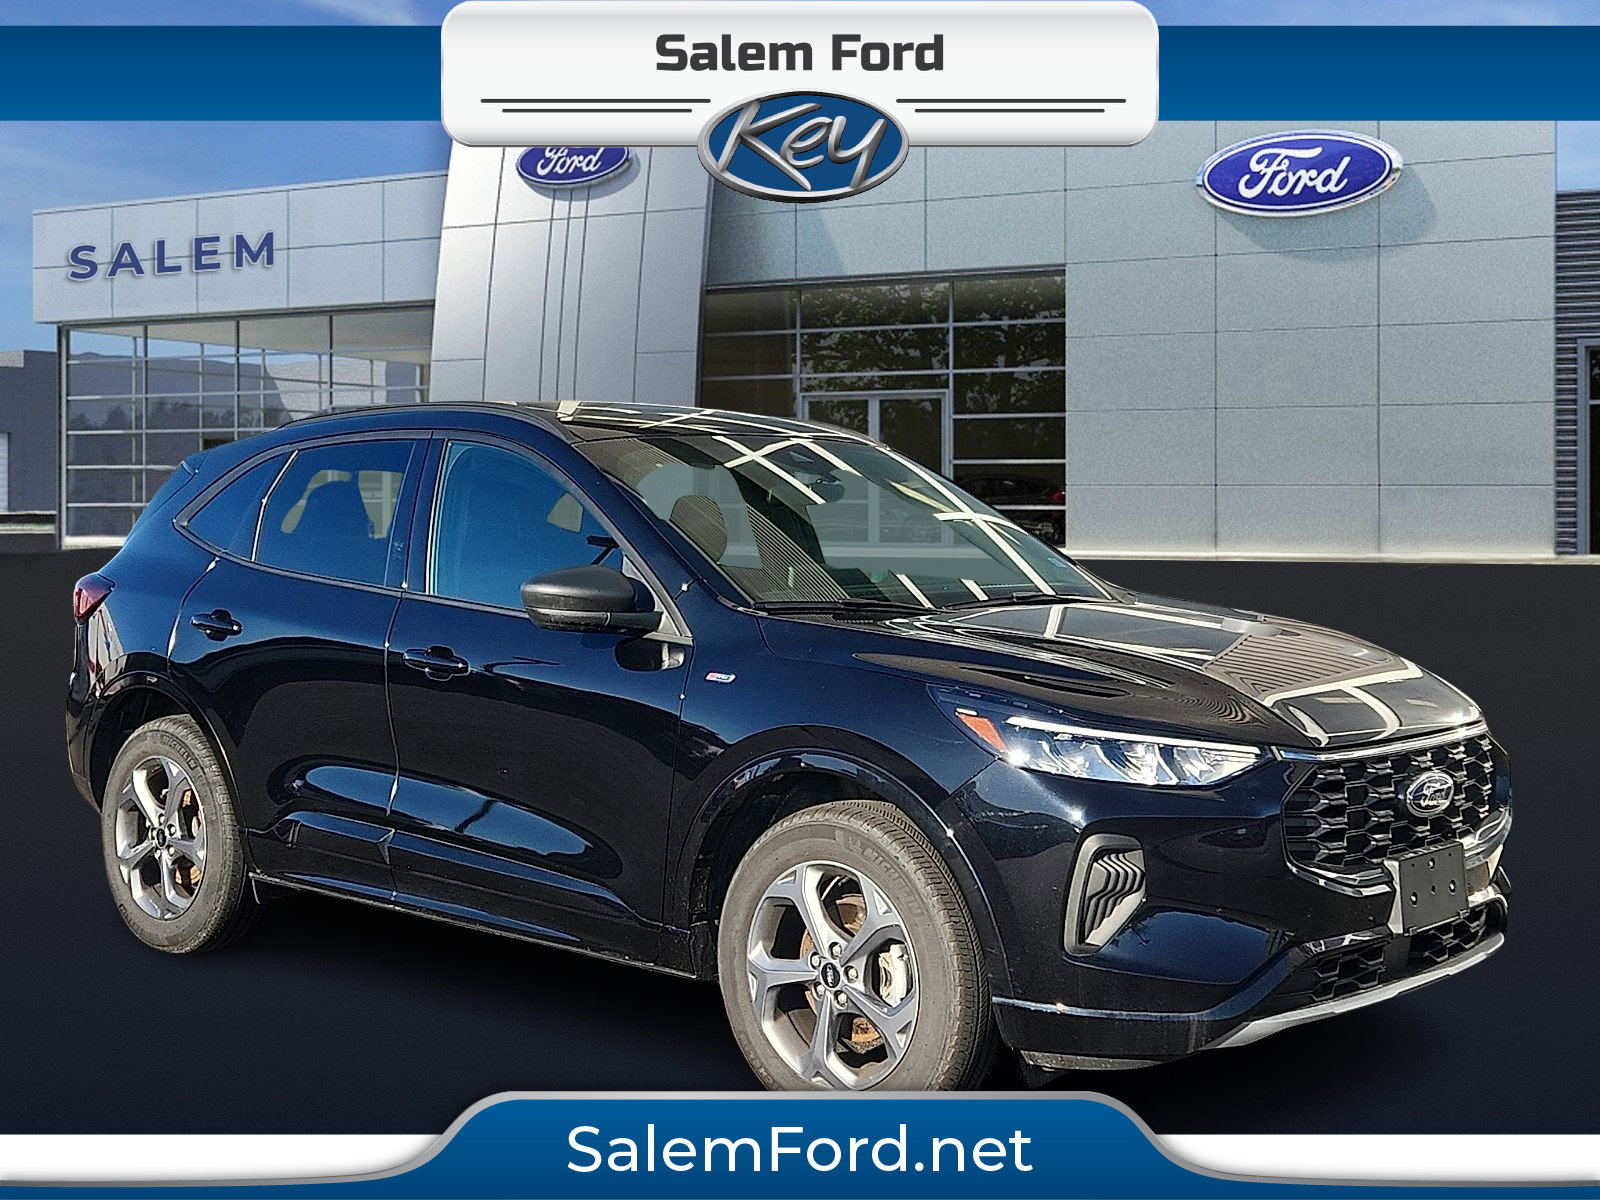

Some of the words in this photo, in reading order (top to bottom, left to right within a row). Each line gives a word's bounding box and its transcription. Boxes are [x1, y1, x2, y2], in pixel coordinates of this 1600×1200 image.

[1238, 147, 1351, 199] Ford
[69, 231, 275, 281] SALEM
[861, 847, 926, 920] MICHELIN
